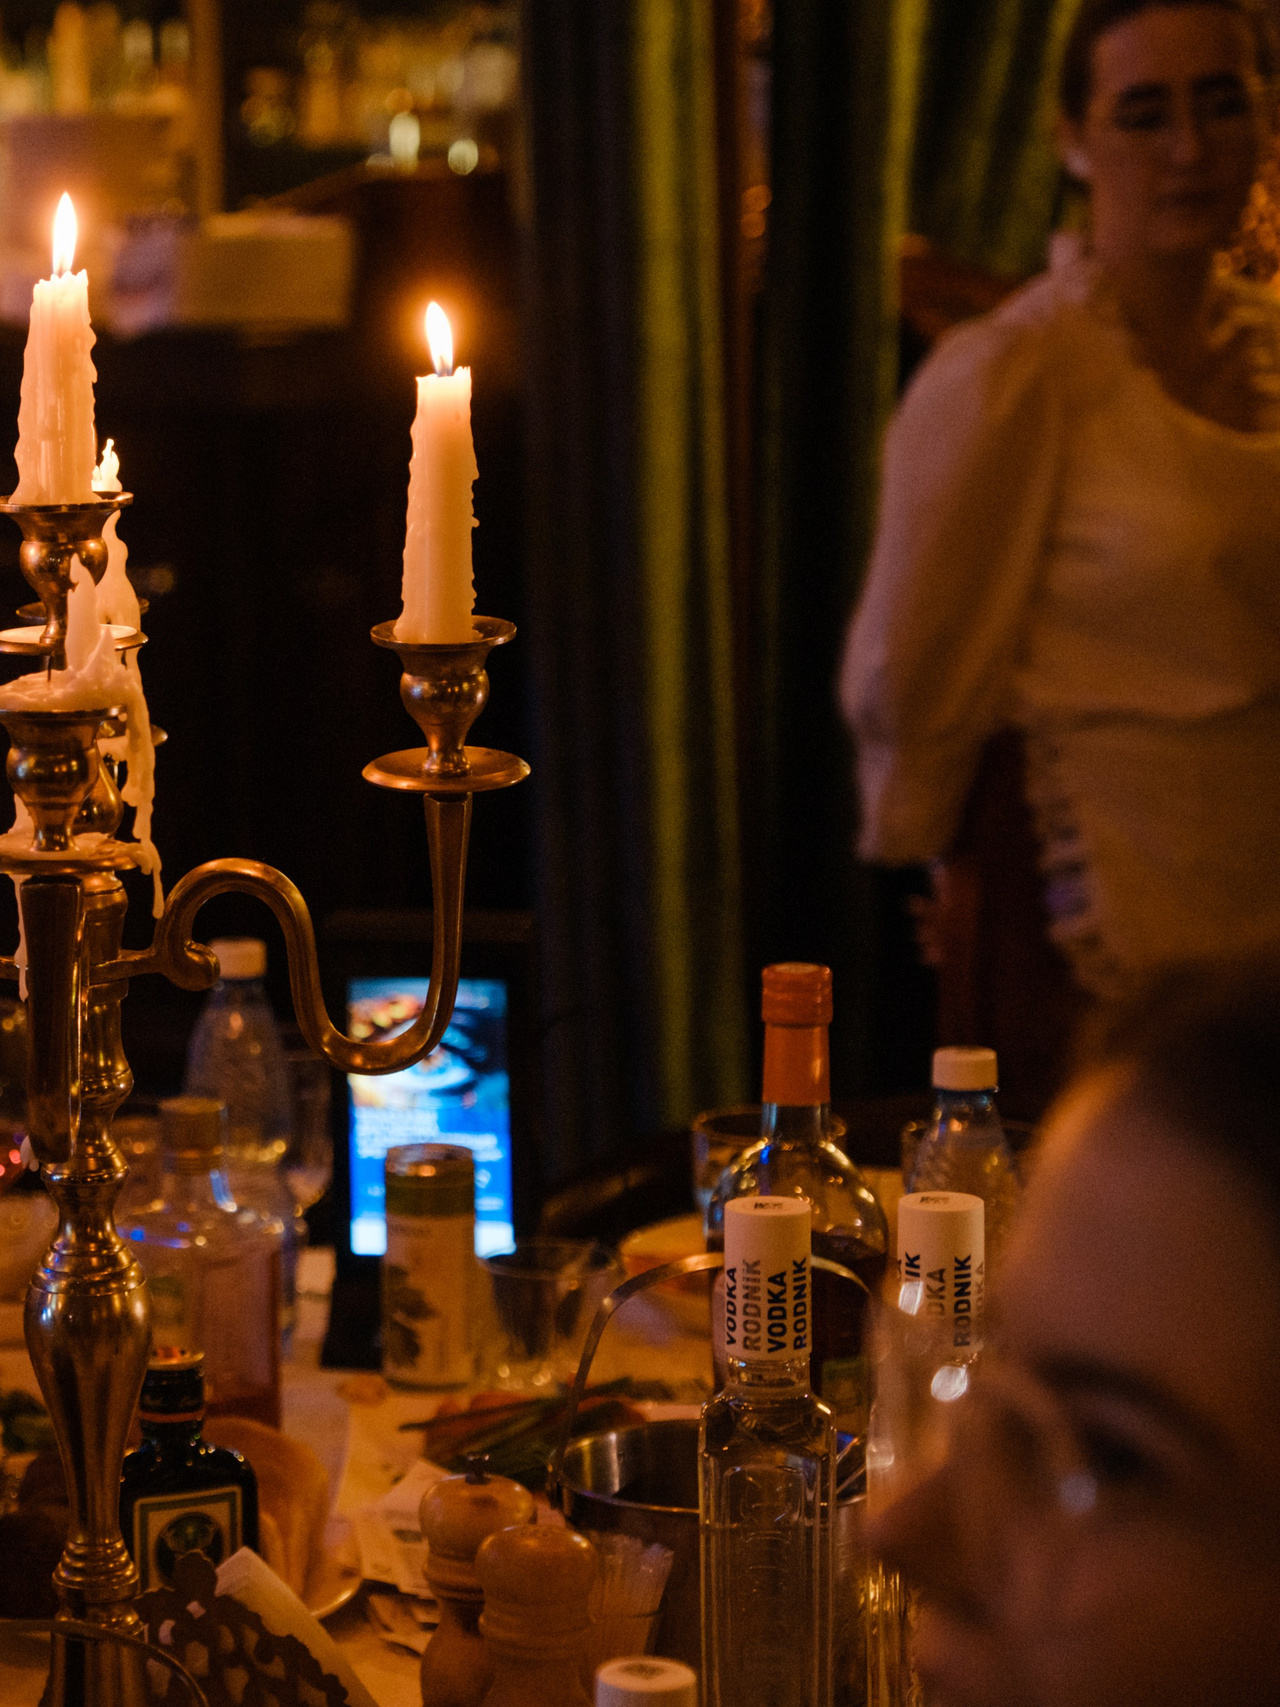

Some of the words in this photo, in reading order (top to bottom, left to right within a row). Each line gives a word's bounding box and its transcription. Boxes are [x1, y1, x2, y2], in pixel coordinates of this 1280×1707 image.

[726, 1267, 737, 1345] VODKA
[742, 1259, 761, 1351] RODNIK
[767, 1271, 787, 1353] VODKA
[793, 1257, 807, 1350] RODNIK
[953, 1255, 971, 1347] RODNIK
